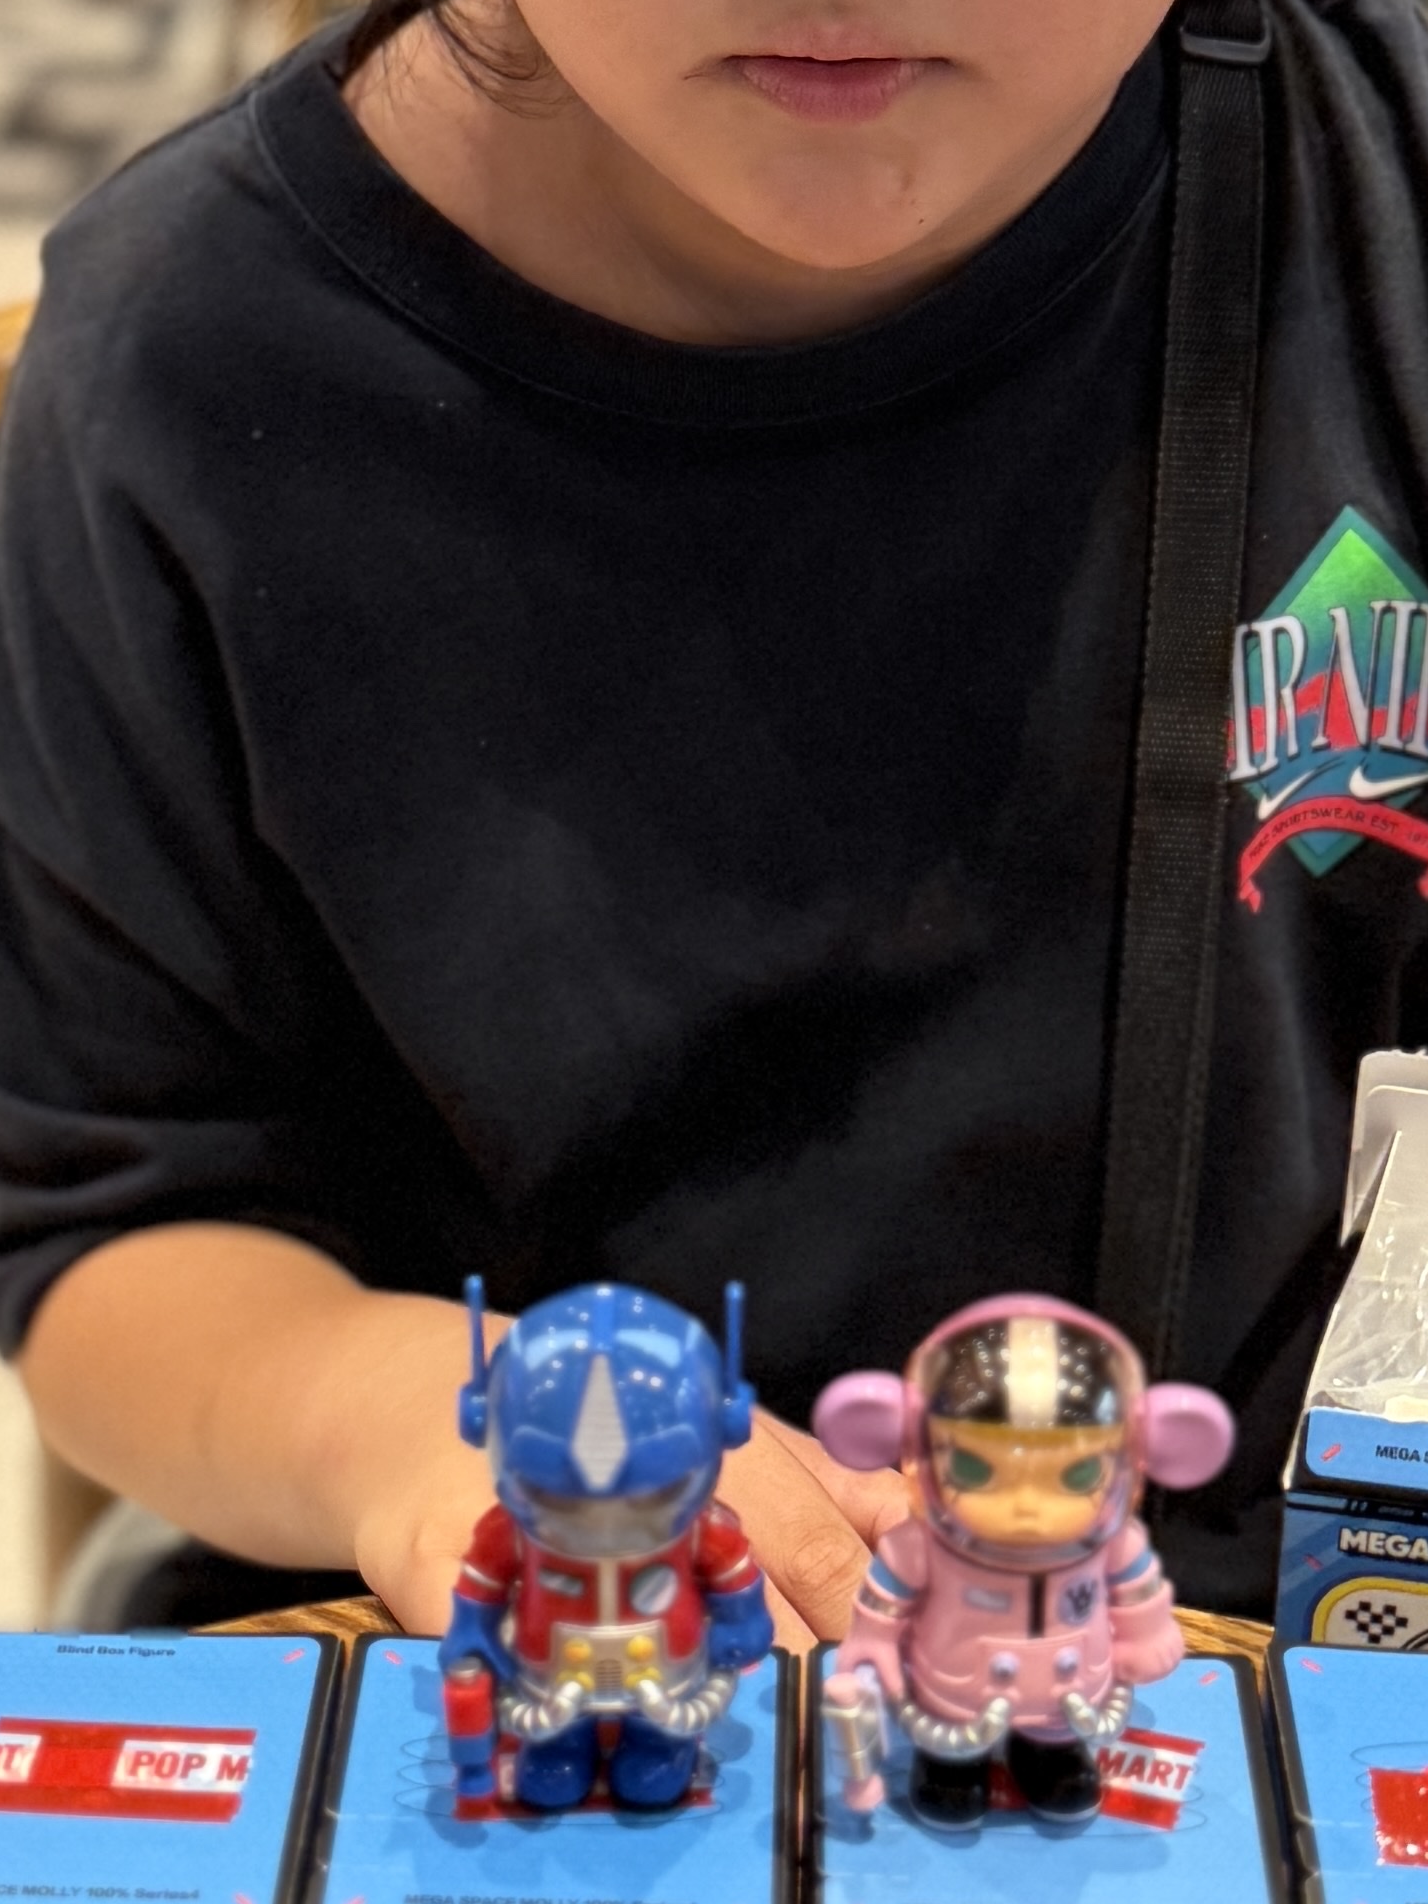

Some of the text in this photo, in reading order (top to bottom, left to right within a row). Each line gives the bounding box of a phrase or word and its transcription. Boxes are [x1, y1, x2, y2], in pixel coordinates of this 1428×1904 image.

[1231, 615, 1307, 780] IR
[1370, 816, 1400, 834] EST
[1375, 1444, 1421, 1464] MEGA
[57, 1644, 176, 1658] Blind Box Figure
[128, 1751, 205, 1778] POP
[1095, 1747, 1194, 1790] MART
[20, 1884, 82, 1897] MOLLY
